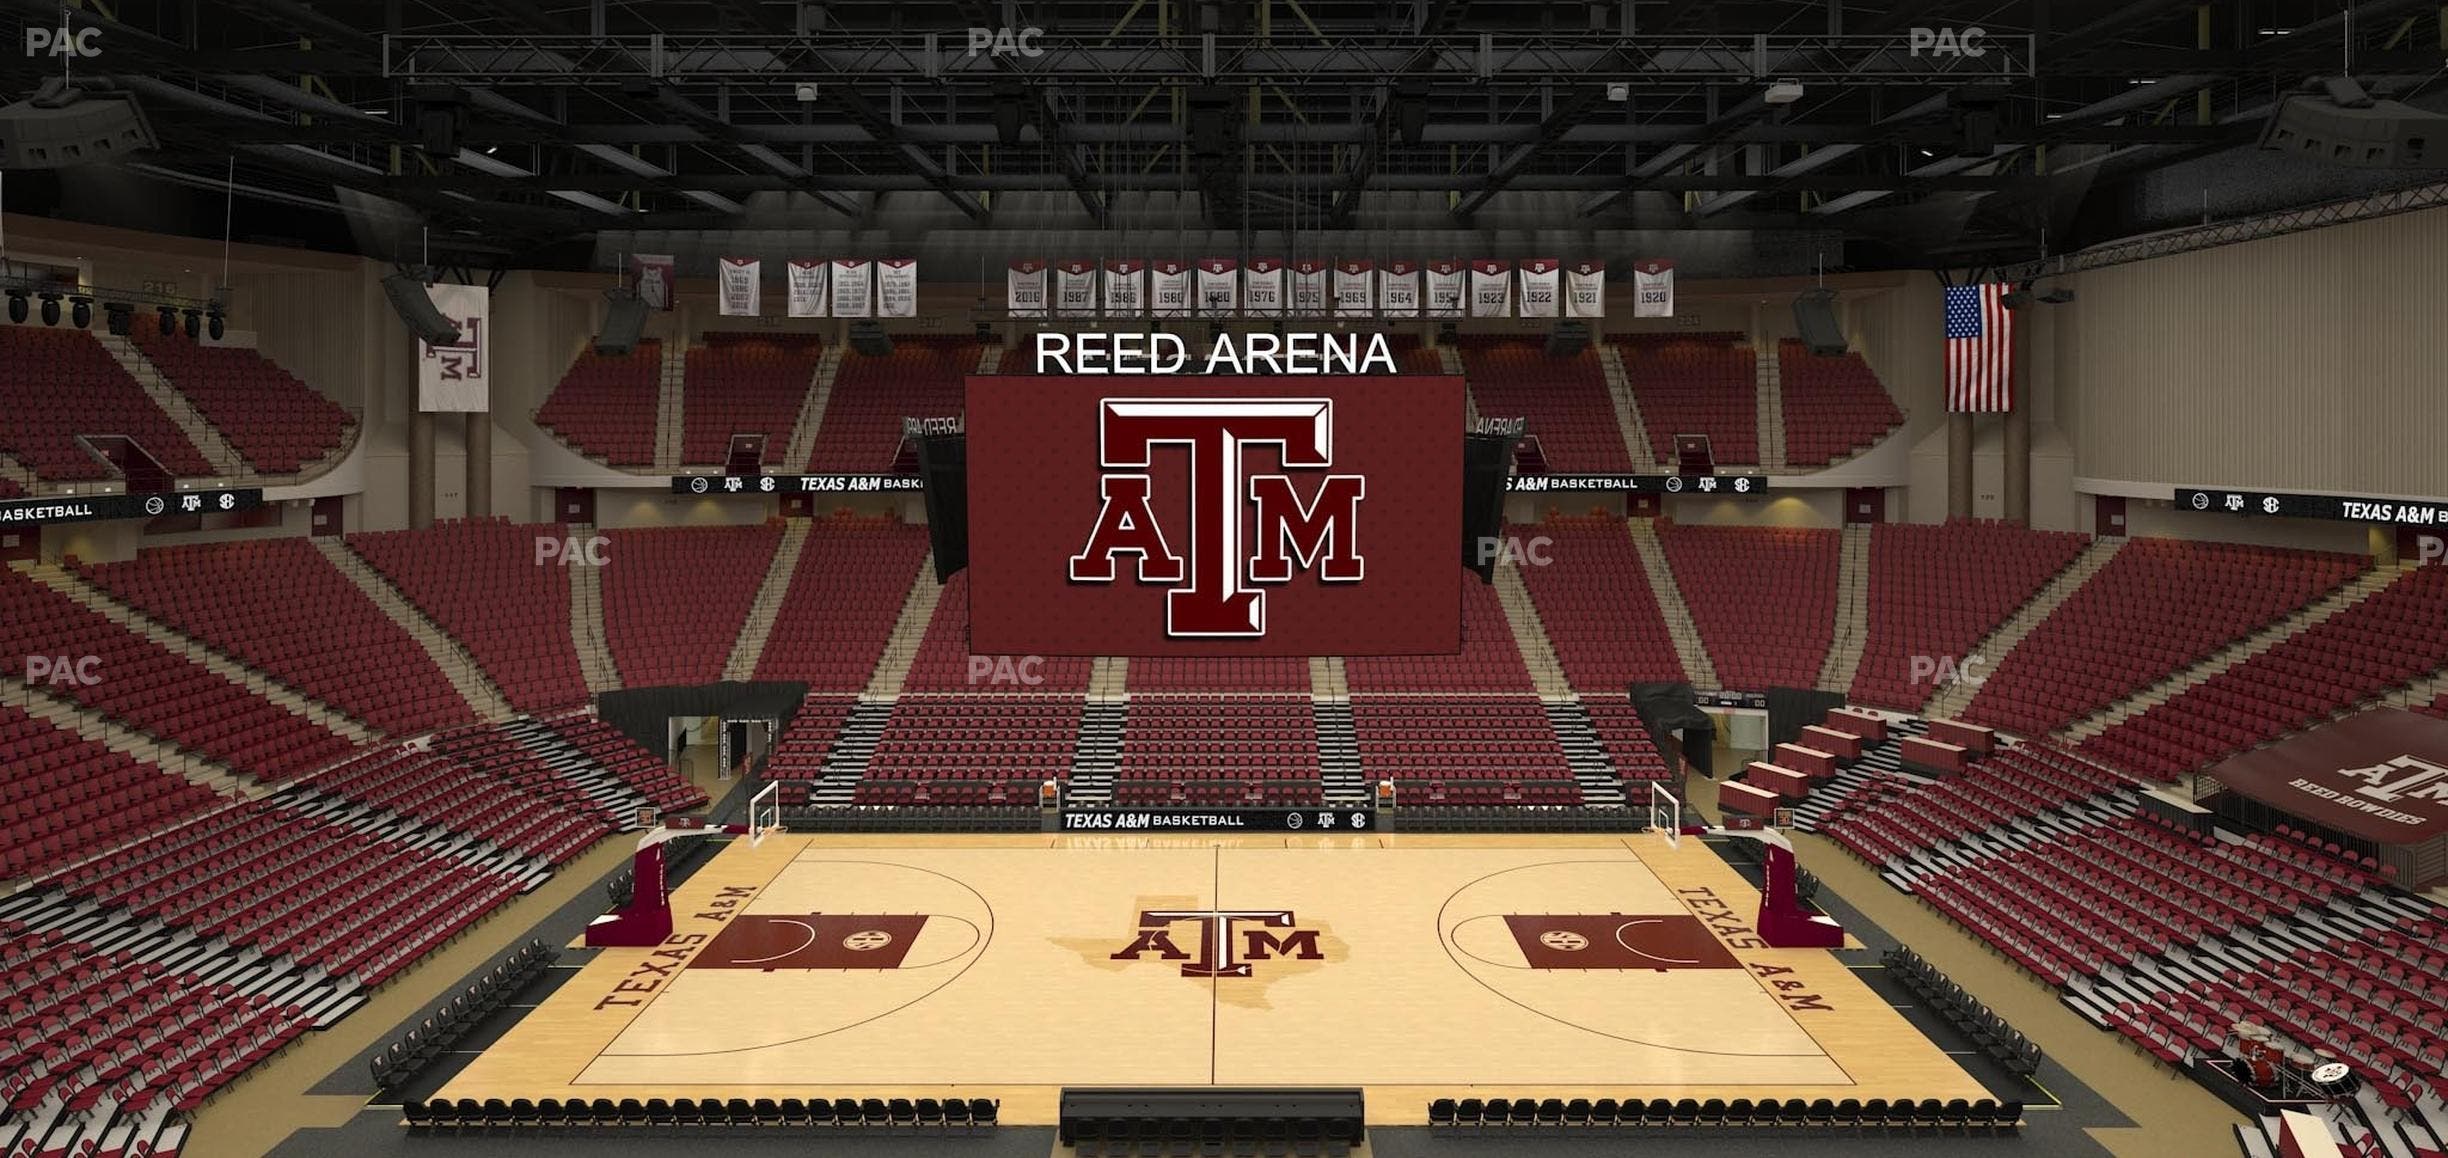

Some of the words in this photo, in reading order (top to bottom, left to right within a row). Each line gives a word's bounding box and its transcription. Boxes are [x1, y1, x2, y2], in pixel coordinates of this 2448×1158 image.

[1063, 291, 1088, 303] 1987
[1249, 291, 1275, 303] 1976
[1479, 292, 1505, 304] 1923
[1527, 291, 1551, 303] 1922
[1573, 291, 1597, 304] 1921
[1641, 291, 1666, 303] 1920
[800, 477, 846, 491] TEXAS
[847, 477, 881, 491] A&M
[1515, 477, 1549, 491] A&M
[1551, 479, 1638, 489] BASKETBALL
[0, 504, 93, 522] ASKETBALL
[2343, 502, 2393, 521] TEXAS
[2395, 505, 2435, 525] A&M
[2288, 778, 2340, 801] REED
[2333, 795, 2428, 825] ROWDIES
[1065, 813, 1112, 829] TEXAS
[1115, 813, 1150, 829] A&M
[1152, 815, 1244, 827] BASKETBALL
[593, 934, 708, 1010] TEXAS
[694, 886, 757, 922] A&M
[1677, 886, 1770, 950] TEXAS
[1749, 962, 1835, 1011] A&M
